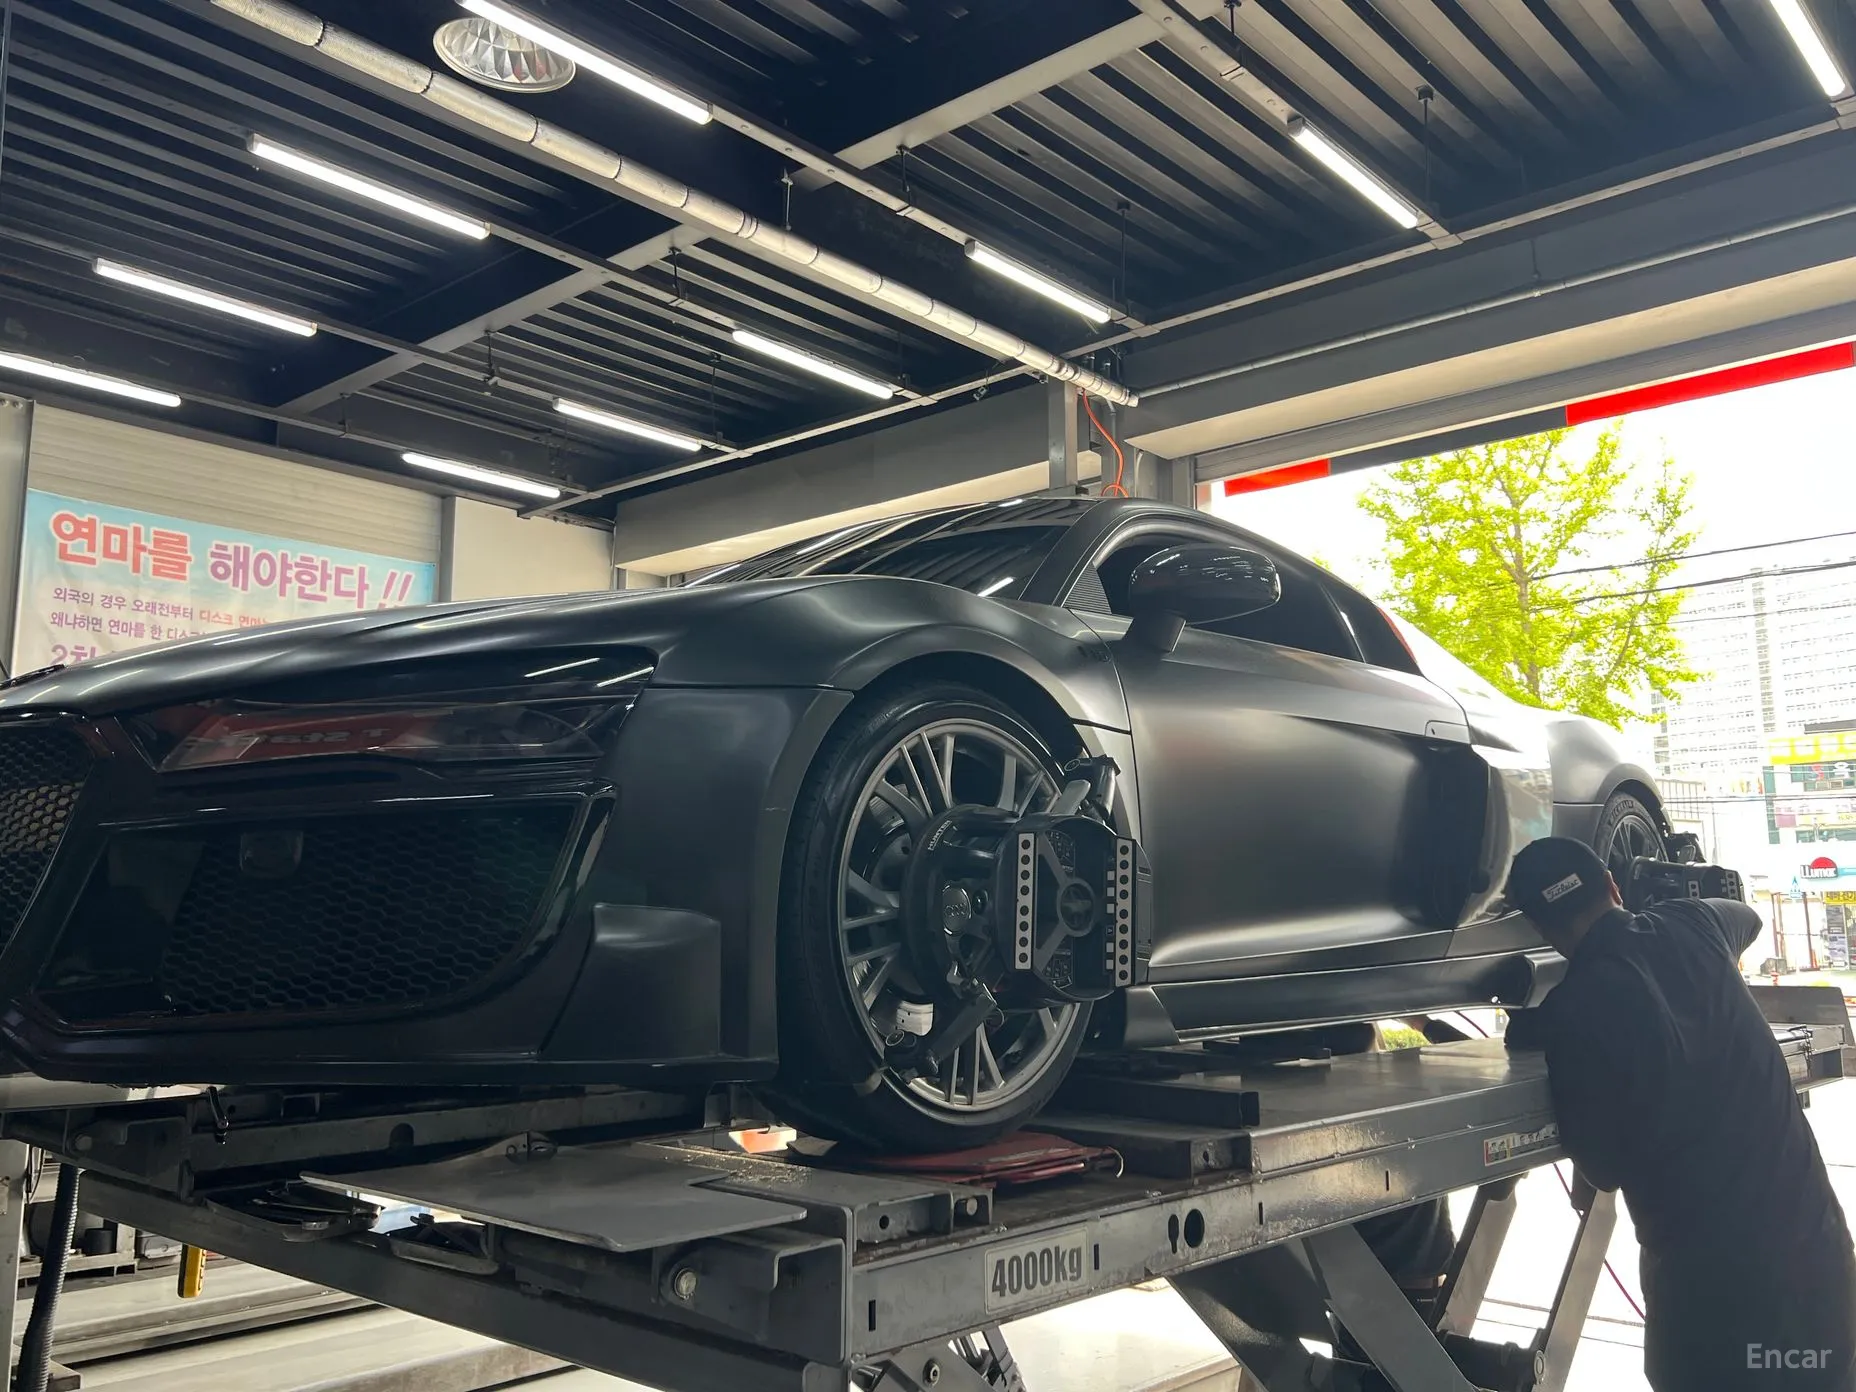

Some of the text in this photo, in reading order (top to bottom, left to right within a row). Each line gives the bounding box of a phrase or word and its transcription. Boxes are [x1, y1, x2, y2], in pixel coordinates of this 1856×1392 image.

[51, 511, 193, 582] 연마를
[209, 543, 370, 609] 해야한다
[50, 611, 103, 633] 왜냐하면
[108, 618, 145, 639] 연마를
[150, 624, 163, 641] 한
[53, 587, 95, 606] 외국의
[100, 594, 127, 610] 경우
[132, 599, 193, 621] 오래전부터
[200, 610, 234, 626] 디스크
[927, 819, 952, 852] HUNTER
[992, 1245, 1082, 1297] 4000kg
